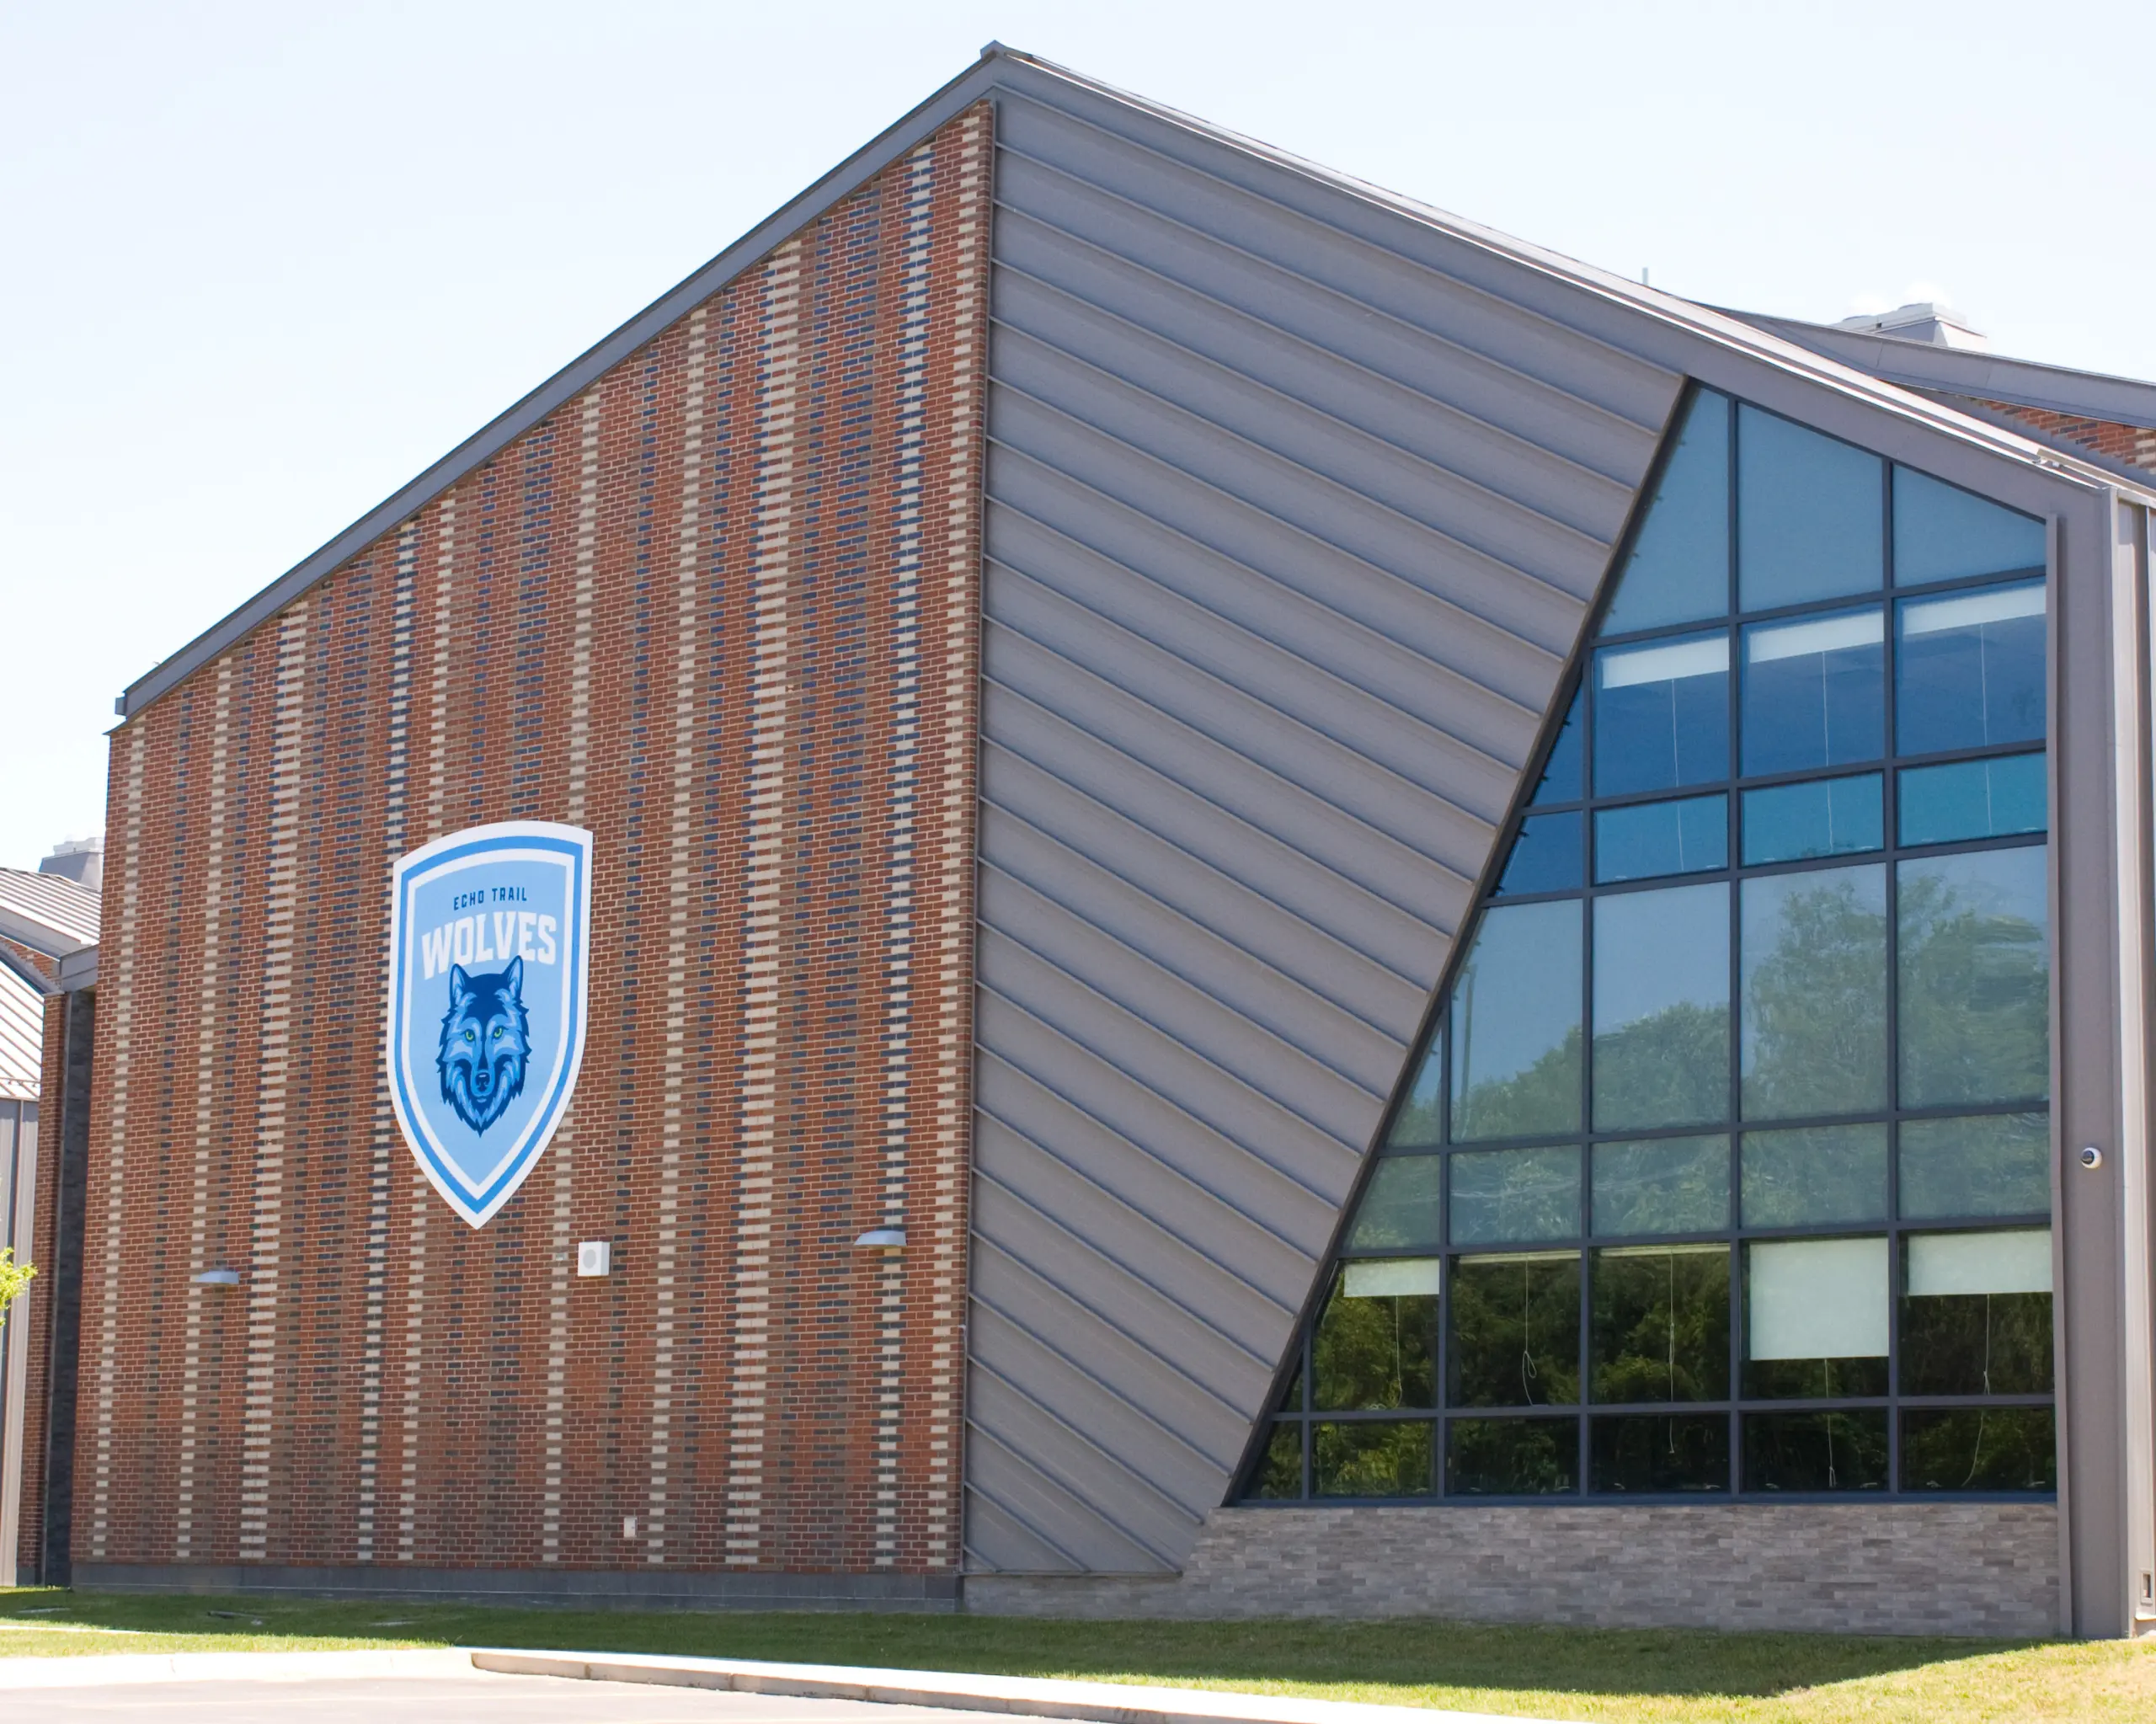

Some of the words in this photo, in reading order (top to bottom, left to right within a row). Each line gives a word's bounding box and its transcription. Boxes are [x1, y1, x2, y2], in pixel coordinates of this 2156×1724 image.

[453, 889, 484, 910] ECHO
[492, 887, 527, 901] TRAIL
[422, 910, 557, 980] WOLVES
